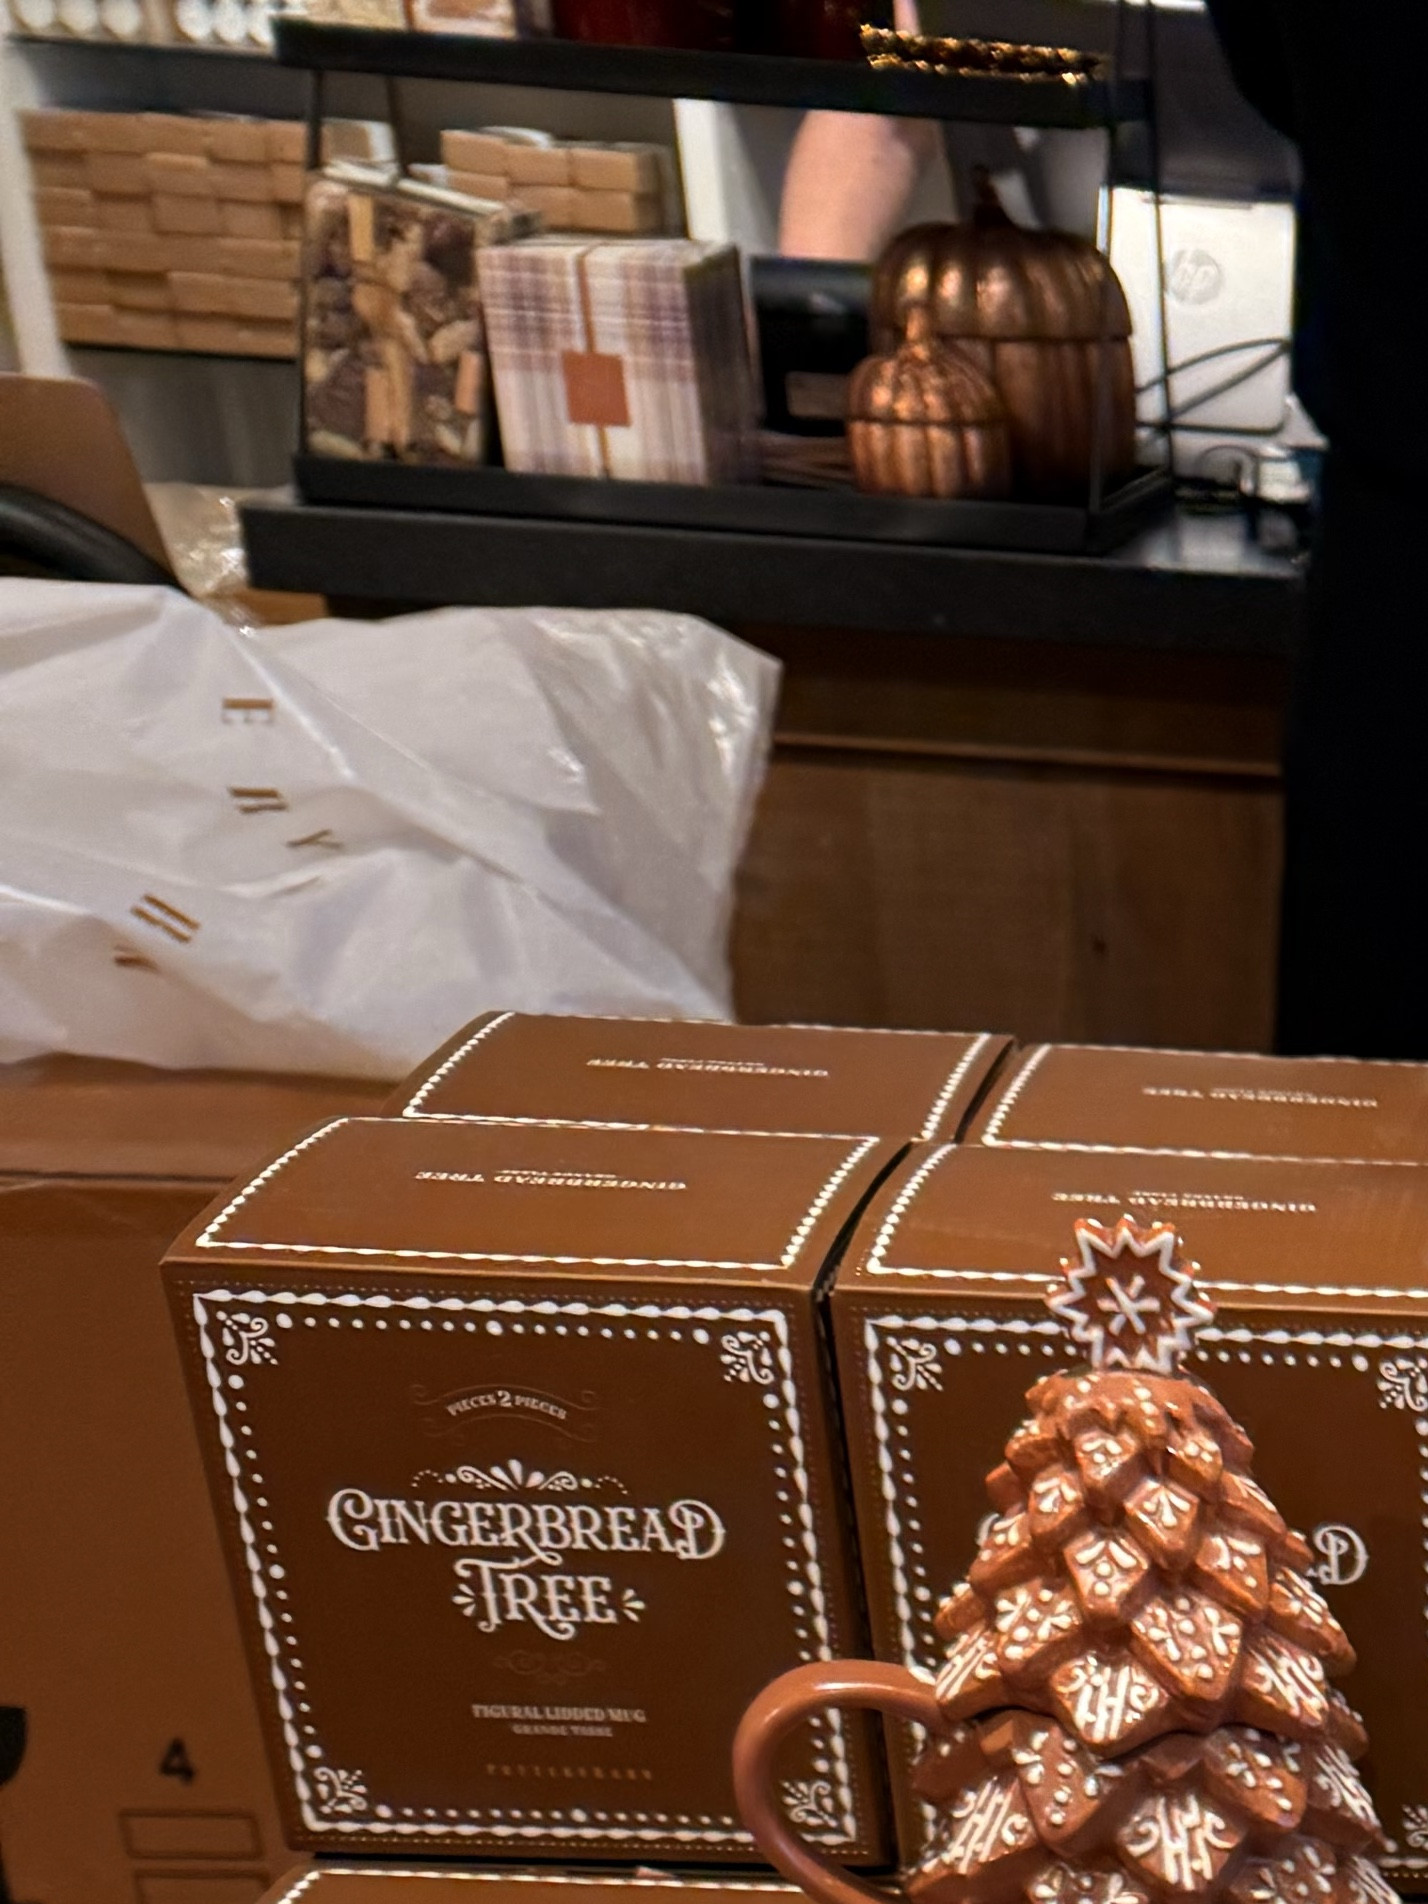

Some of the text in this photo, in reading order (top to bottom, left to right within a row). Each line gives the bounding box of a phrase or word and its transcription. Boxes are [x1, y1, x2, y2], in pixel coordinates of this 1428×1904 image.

[415, 1171, 485, 1182] TREE
[494, 1174, 686, 1189] GINGERBREAD
[446, 1390, 568, 1420] PIECES 2 PIECES
[326, 1487, 726, 1566] GINGERBREAD
[453, 1557, 618, 1640] TREE
[608, 1708, 647, 1723] MUG
[158, 1737, 196, 1787] 4
